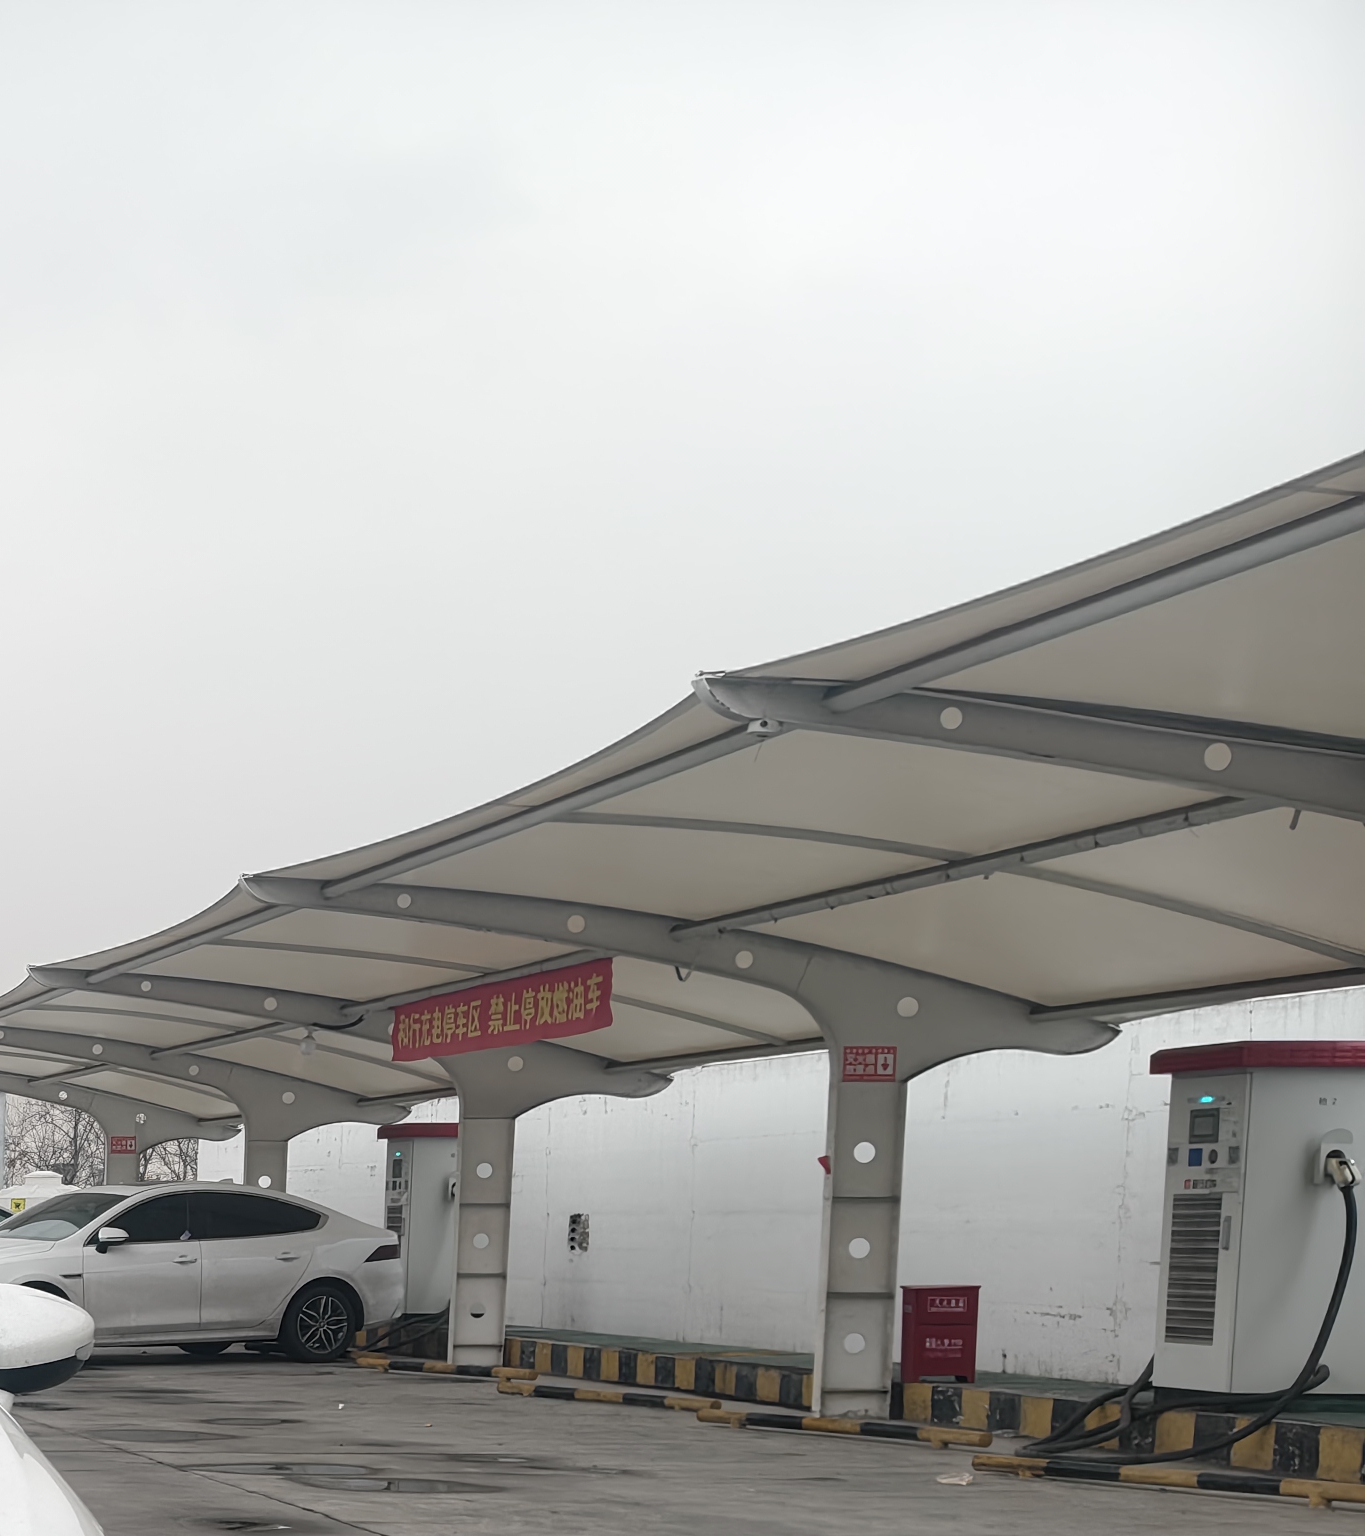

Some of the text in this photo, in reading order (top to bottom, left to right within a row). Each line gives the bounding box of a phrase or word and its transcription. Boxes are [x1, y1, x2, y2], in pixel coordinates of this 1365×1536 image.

[397, 973, 603, 1050] 和行充电停车区 禁止停放燃油车
